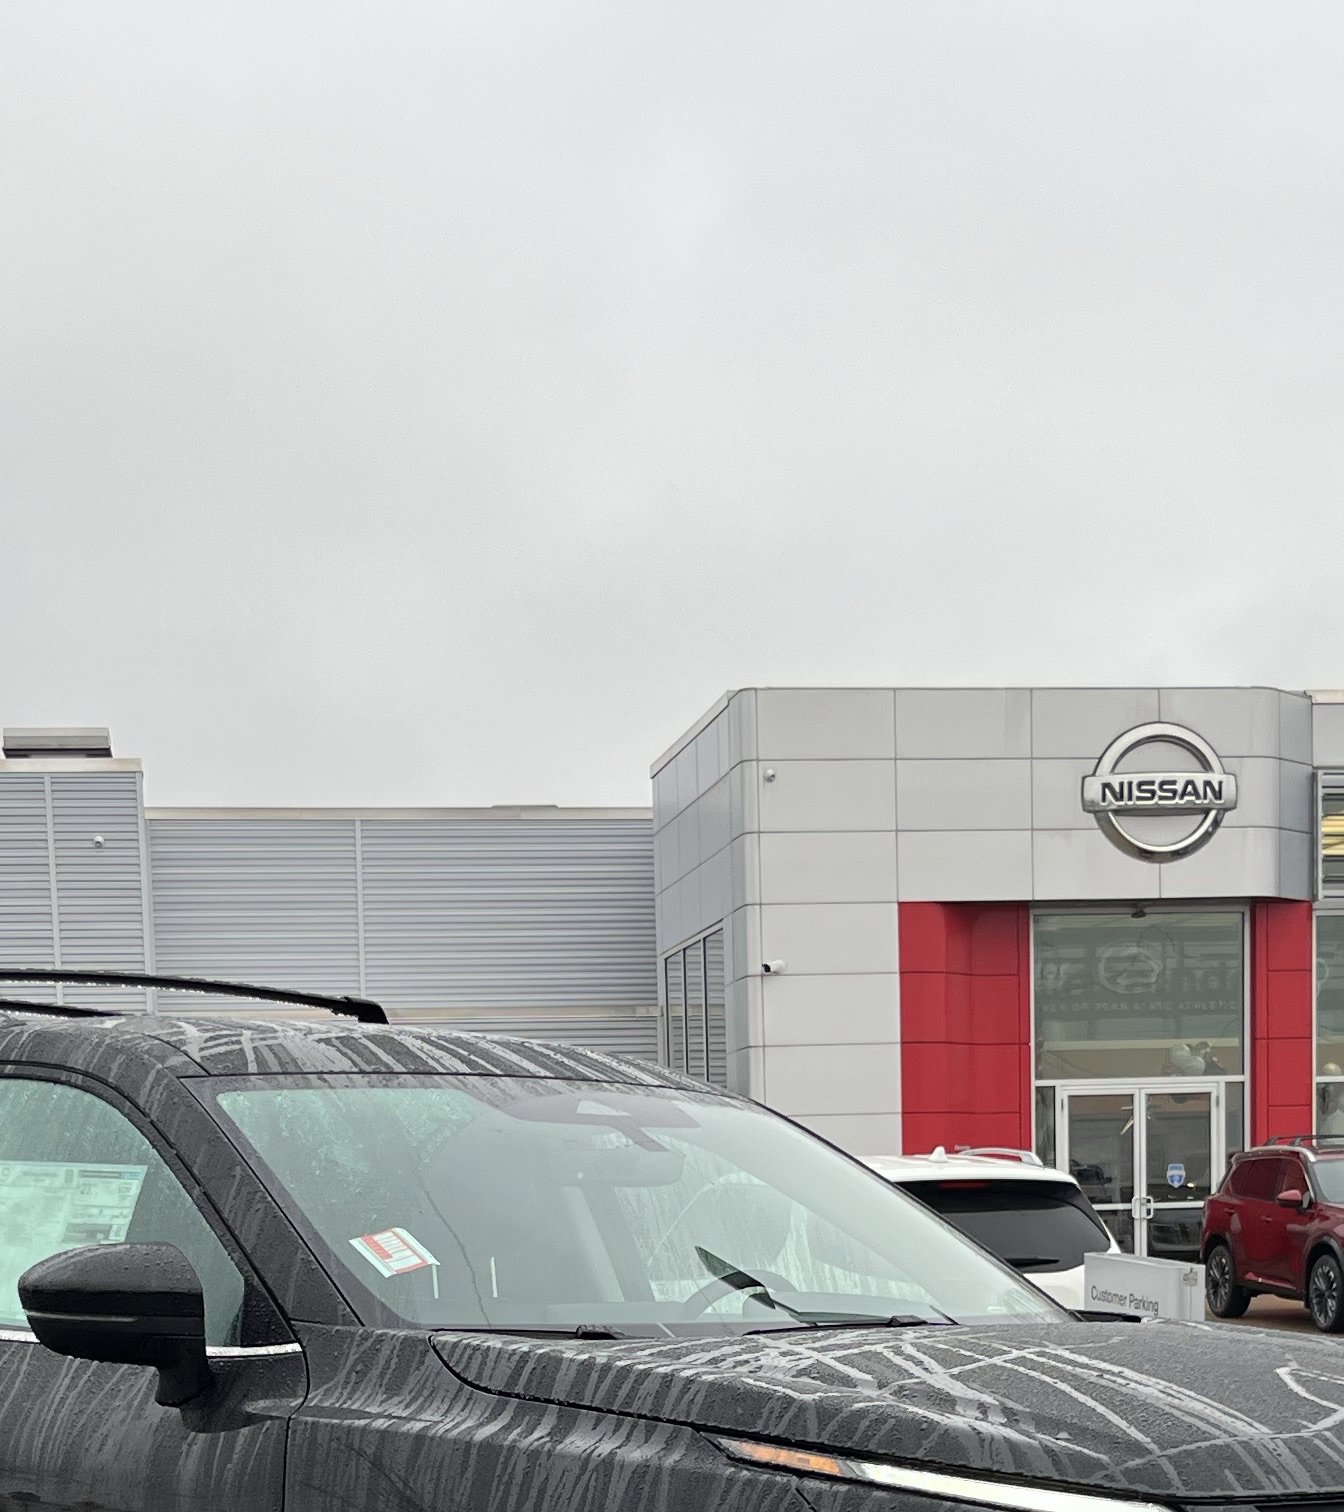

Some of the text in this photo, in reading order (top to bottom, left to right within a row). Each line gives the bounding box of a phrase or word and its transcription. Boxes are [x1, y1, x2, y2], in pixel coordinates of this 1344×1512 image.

[1100, 779, 1224, 803] NISSAN
[1090, 1285, 1159, 1316] Customer Parking
